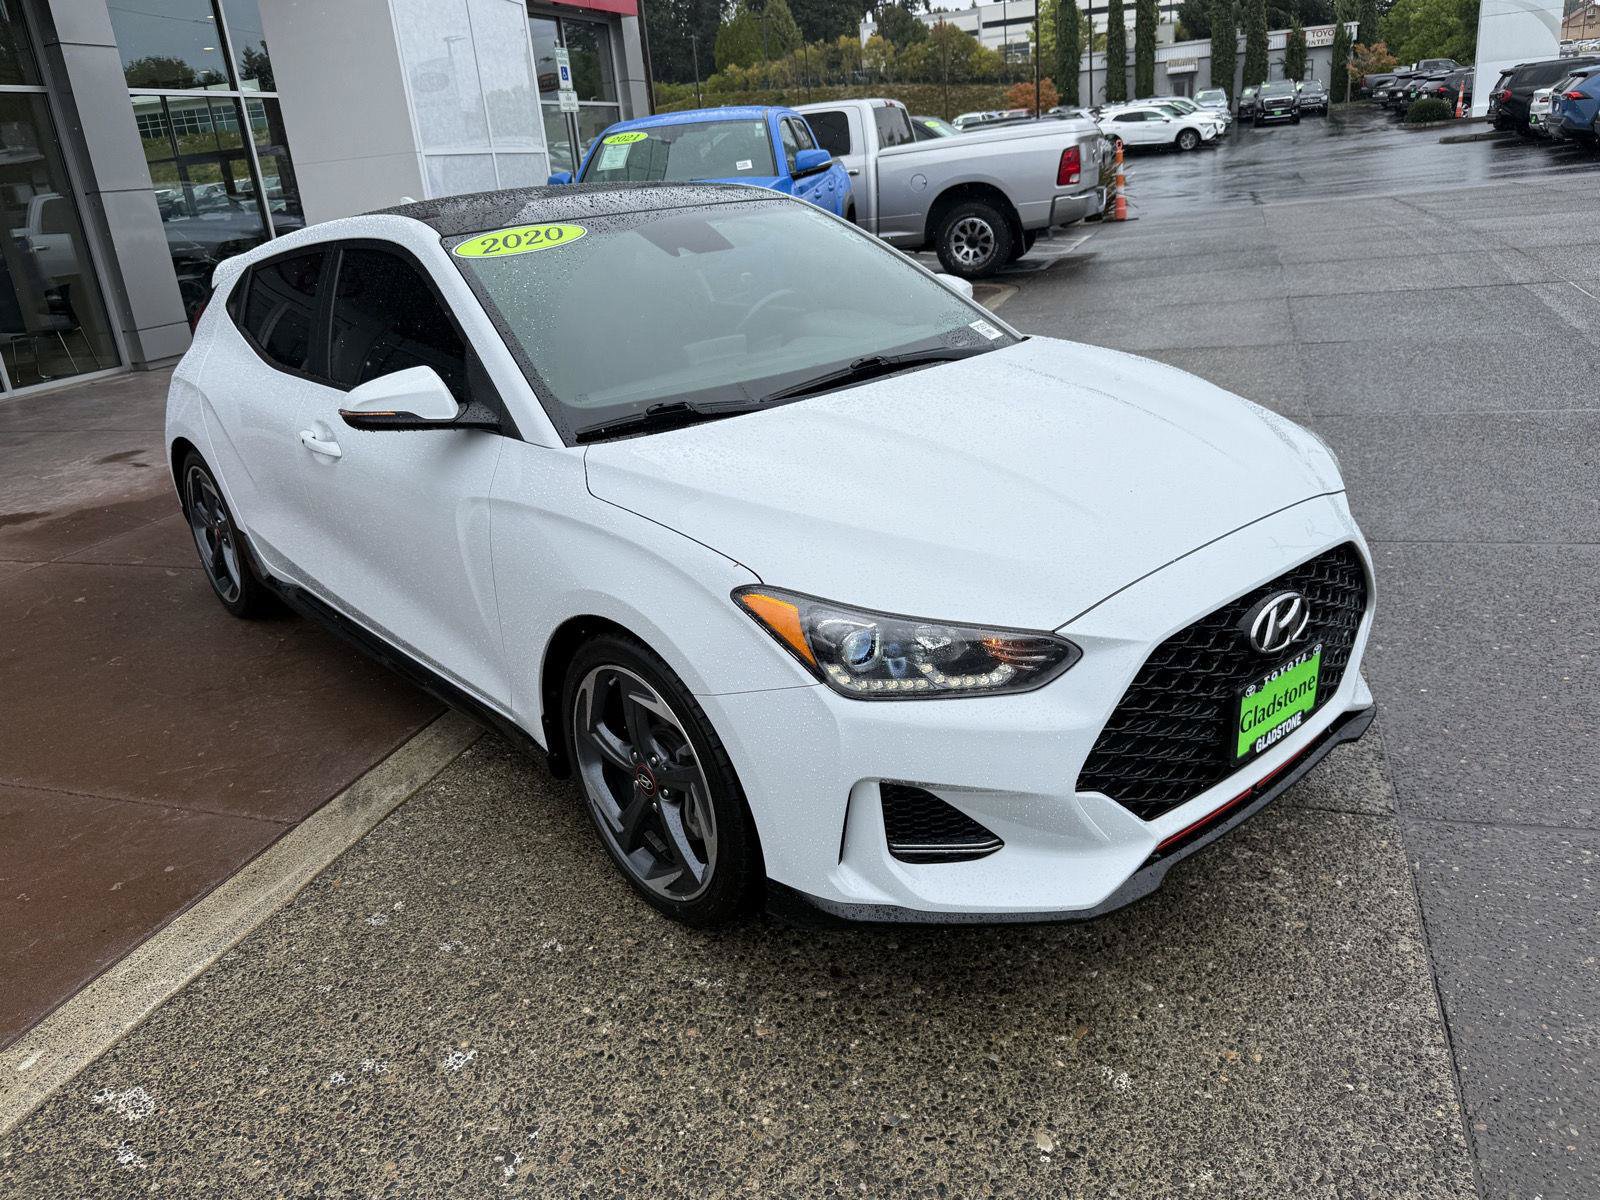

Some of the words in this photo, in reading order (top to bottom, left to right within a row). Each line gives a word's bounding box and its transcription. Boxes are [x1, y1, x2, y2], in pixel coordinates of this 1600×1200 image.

[1311, 30, 1335, 38] TOYO
[481, 227, 564, 255] 2020
[1263, 652, 1308, 686] TOYOTA
[1240, 675, 1316, 734] Gladstone
[1255, 711, 1303, 754] GLADSTONE
